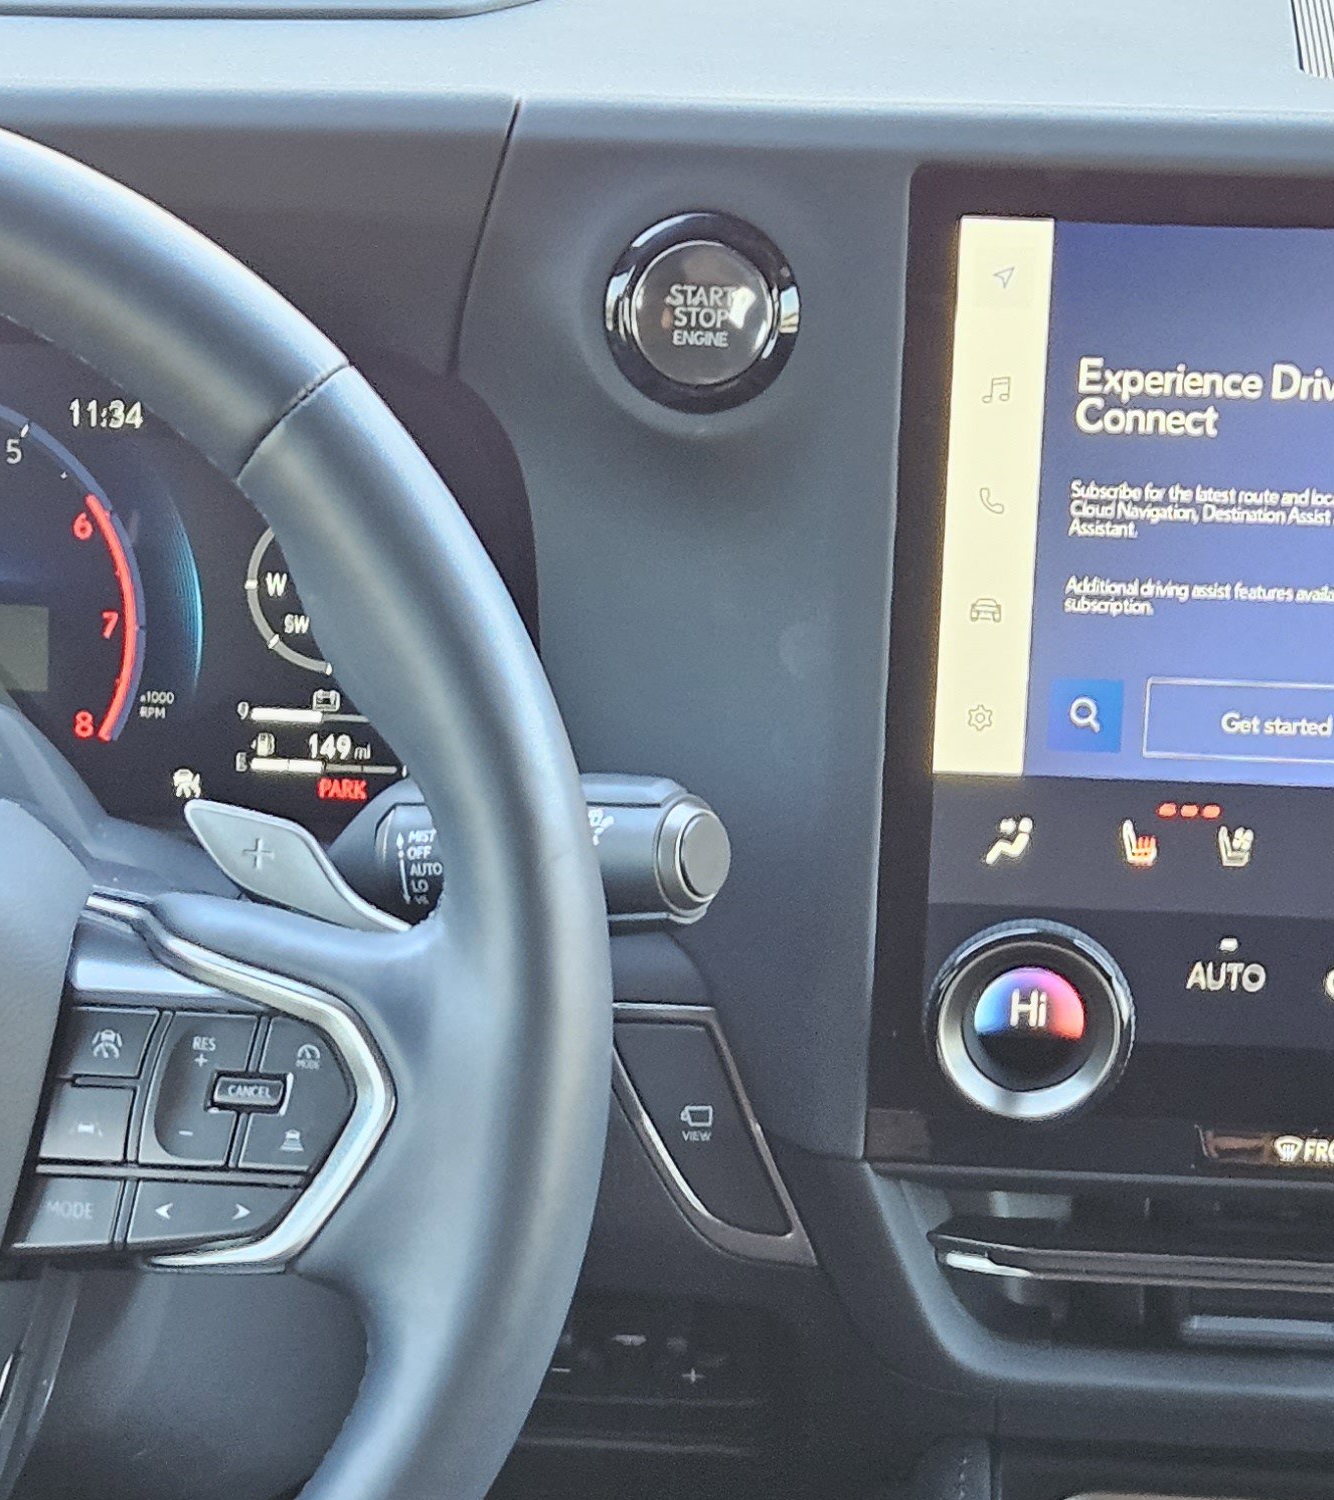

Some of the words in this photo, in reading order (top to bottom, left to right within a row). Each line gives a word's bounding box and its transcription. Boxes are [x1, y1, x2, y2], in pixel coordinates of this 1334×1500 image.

[668, 284, 736, 307] START
[673, 307, 729, 328] STOP
[672, 330, 729, 348] ENGINE
[1077, 356, 1264, 404] Experience
[69, 399, 144, 430] 11:34
[1075, 397, 1219, 438] Connect
[5, 438, 23, 465] 5
[1070, 479, 1141, 501] Subscribe
[1144, 482, 1166, 501] for
[1168, 483, 1193, 502] the
[1195, 484, 1236, 505] latest
[1238, 487, 1280, 506] route
[1281, 488, 1310, 507] and
[1069, 500, 1115, 519] Cloud
[1116, 501, 1199, 525] Navigation,
[1202, 503, 1286, 525] Destination
[1287, 506, 1331, 527] Assist
[72, 513, 94, 541] 6
[1068, 517, 1139, 539] Assistant.
[266, 572, 288, 597] W
[1065, 575, 1141, 597] Additional
[1141, 579, 1190, 604] driving
[1191, 583, 1232, 602] assist
[1234, 581, 1294, 602] features
[1064, 596, 1155, 617] subscription.
[102, 611, 119, 640] 7
[284, 613, 311, 634] SW
[74, 710, 94, 739] 8
[1221, 710, 1261, 736] Get
[1263, 712, 1334, 738] started
[308, 732, 352, 761] 149
[317, 777, 367, 801] PARK
[406, 845, 433, 860] OFF
[410, 861, 444, 877] AUTO
[1185, 962, 1267, 994] AUTO
[1008, 988, 1049, 1030] Hi
[192, 1036, 217, 1052] RES
[227, 1084, 273, 1100] CANCEL
[682, 1130, 713, 1142] VIEW
[45, 1199, 94, 1221] MODE
